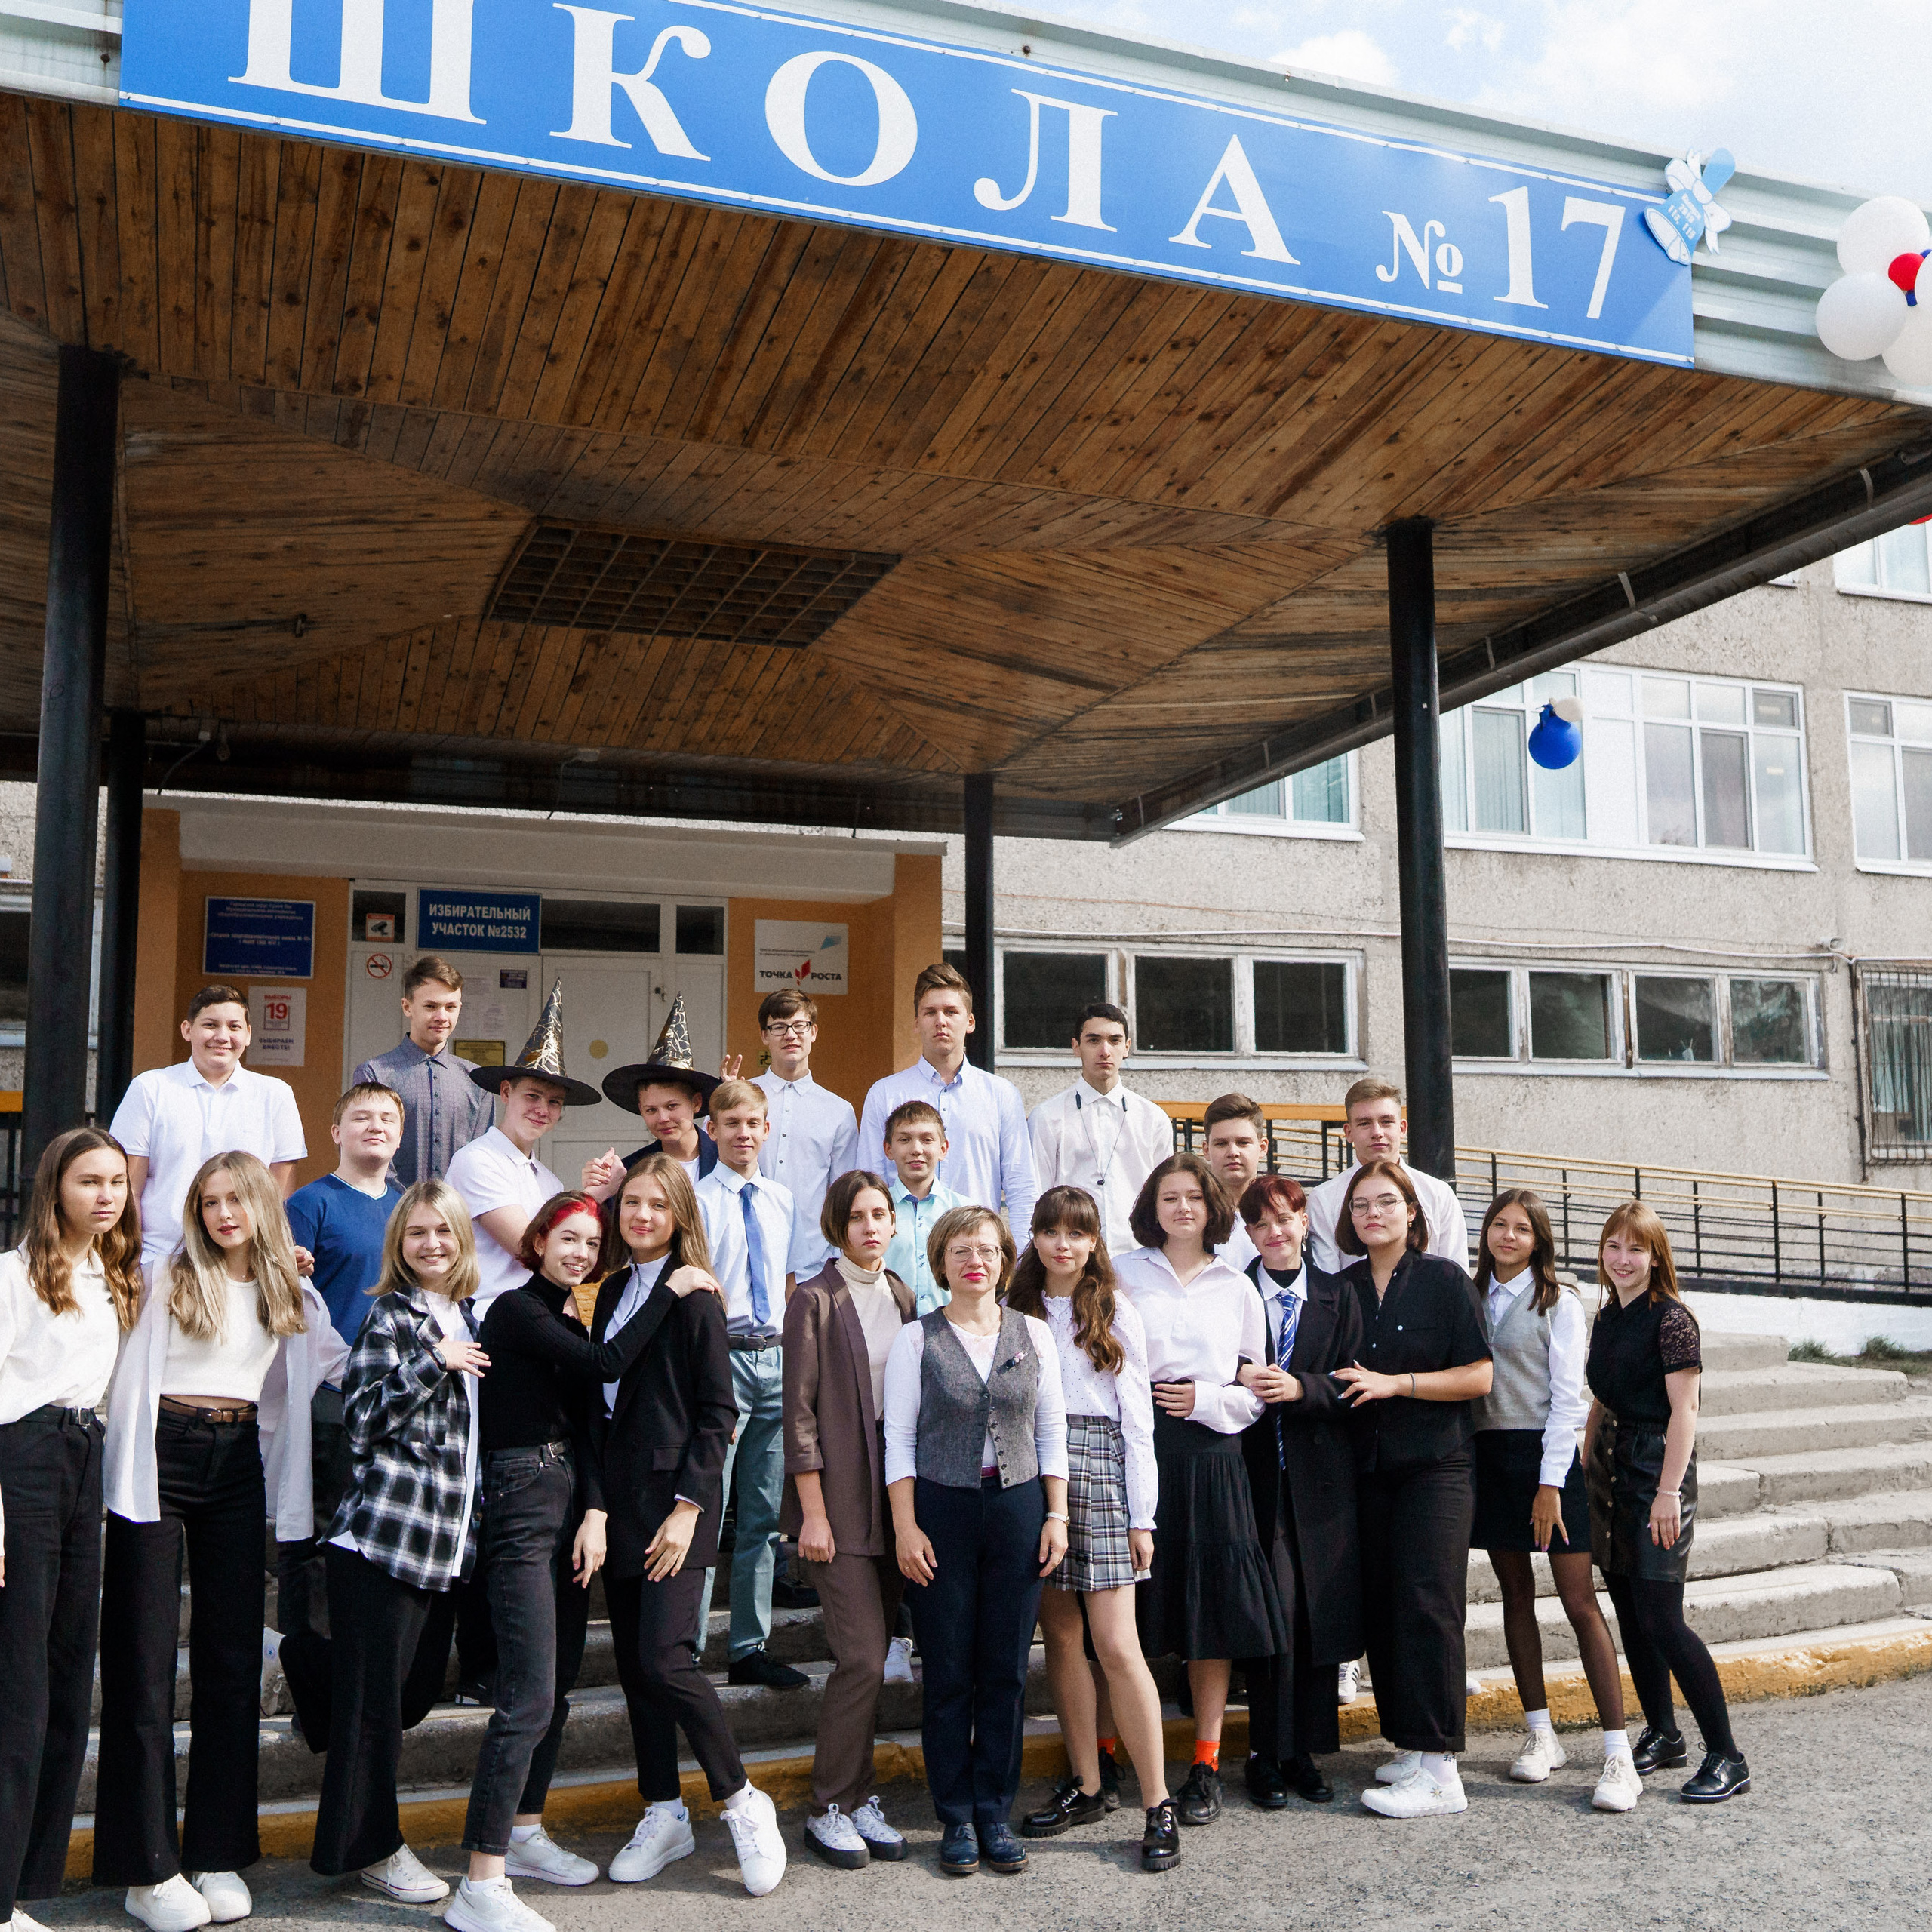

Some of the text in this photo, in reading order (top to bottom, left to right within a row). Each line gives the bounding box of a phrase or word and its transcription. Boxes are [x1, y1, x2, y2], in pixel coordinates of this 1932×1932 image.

[429, 903, 531, 921] ИЗБИРАТЕЛЬНЫЙ
[432, 922, 527, 939] УЧАСТОК №2532
[759, 970, 842, 980] ТОЧКА РОСТА
[266, 1002, 288, 1020] 19
